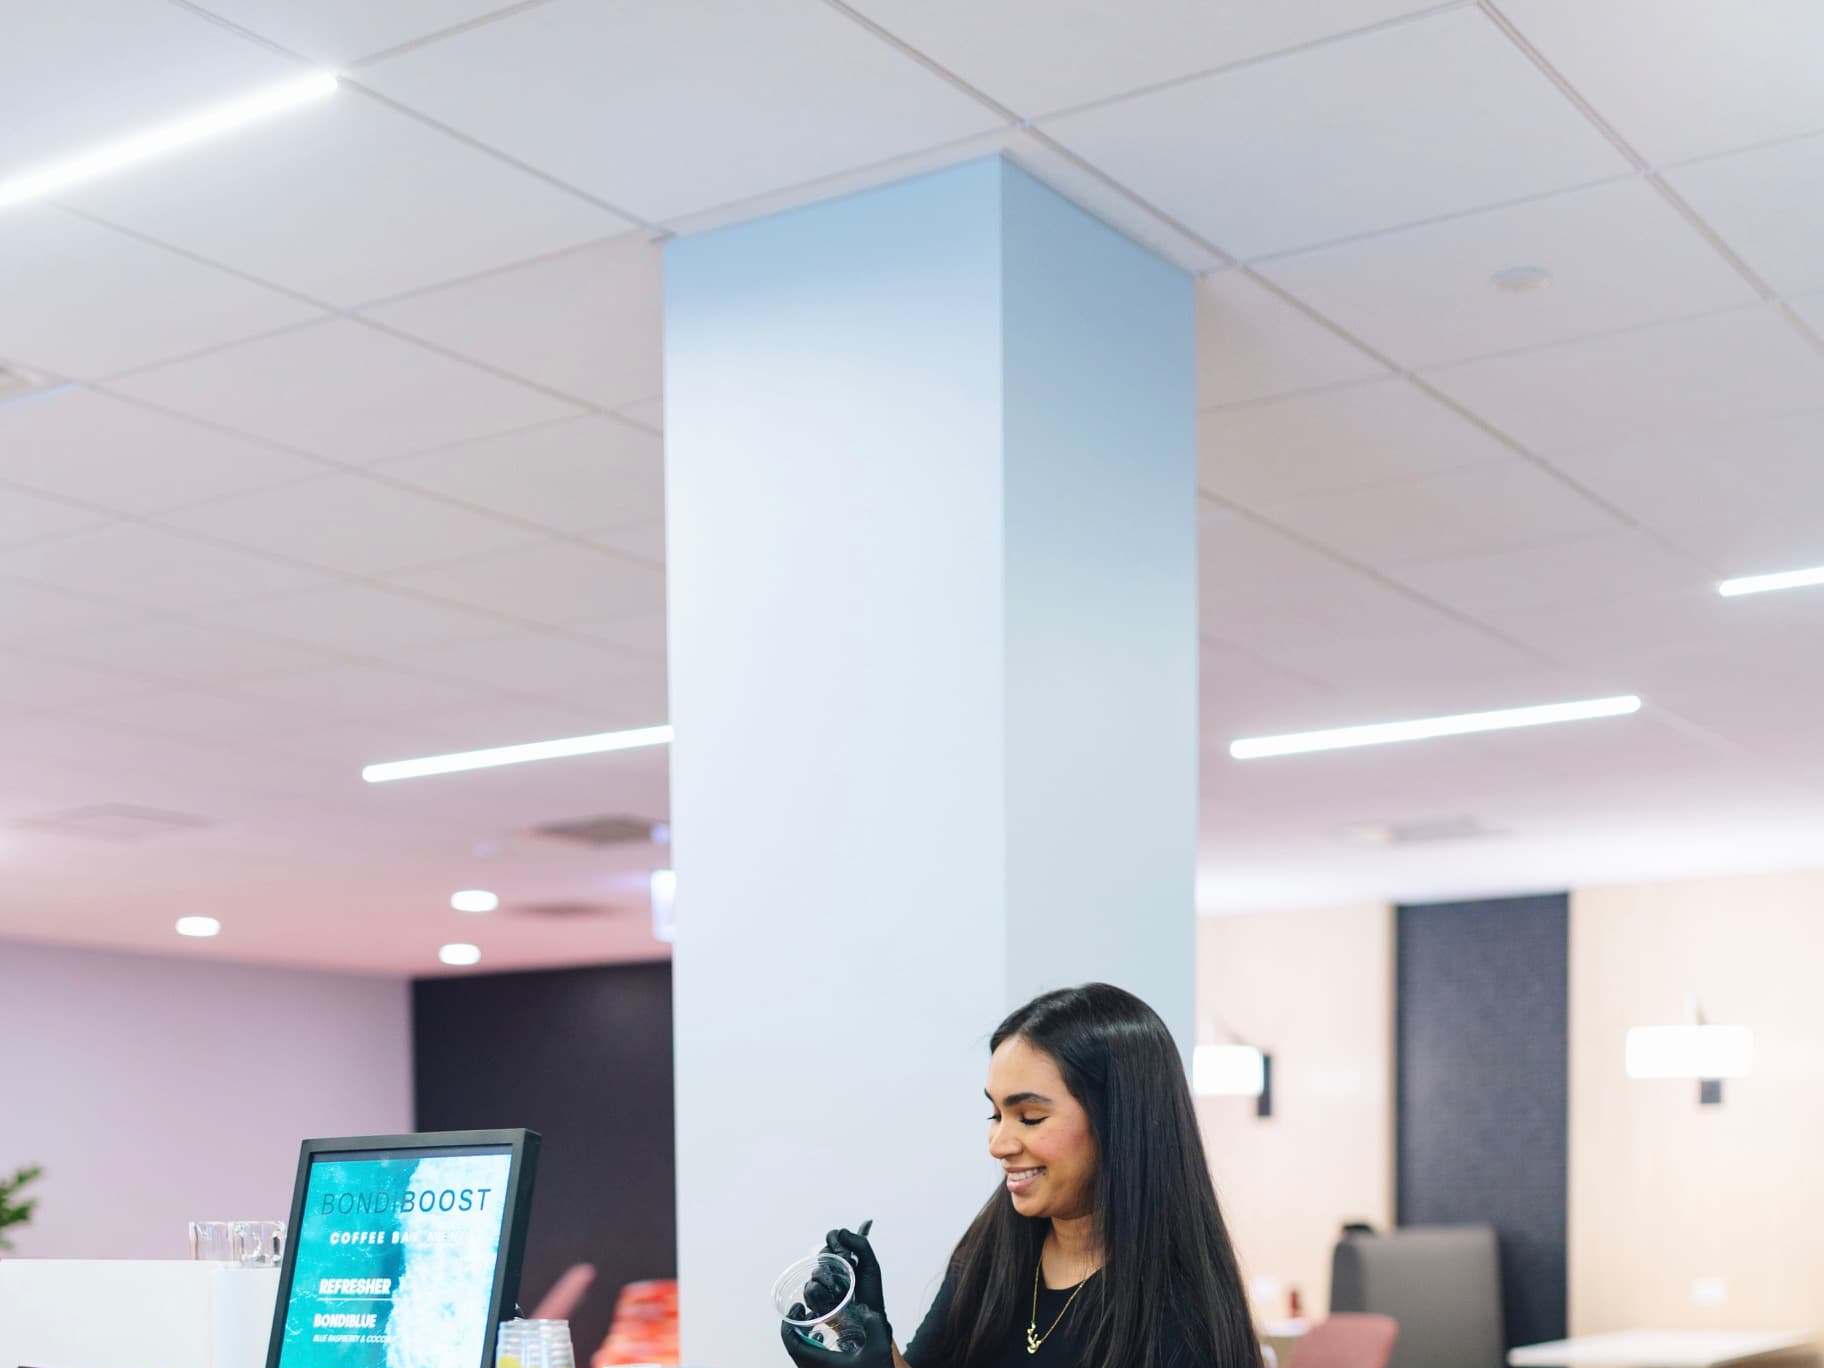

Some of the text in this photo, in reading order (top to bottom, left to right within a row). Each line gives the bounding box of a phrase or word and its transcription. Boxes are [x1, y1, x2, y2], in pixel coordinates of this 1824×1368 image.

[321, 1188, 492, 1215] BONDIBOOST
[329, 1231, 385, 1245] COFFEE
[391, 1231, 418, 1244] BAR
[318, 1278, 392, 1295] REFRESHER
[313, 1313, 377, 1329] BONDIBLUE
[313, 1334, 328, 1342] BLUE
[328, 1334, 360, 1343] RASPBERRY
